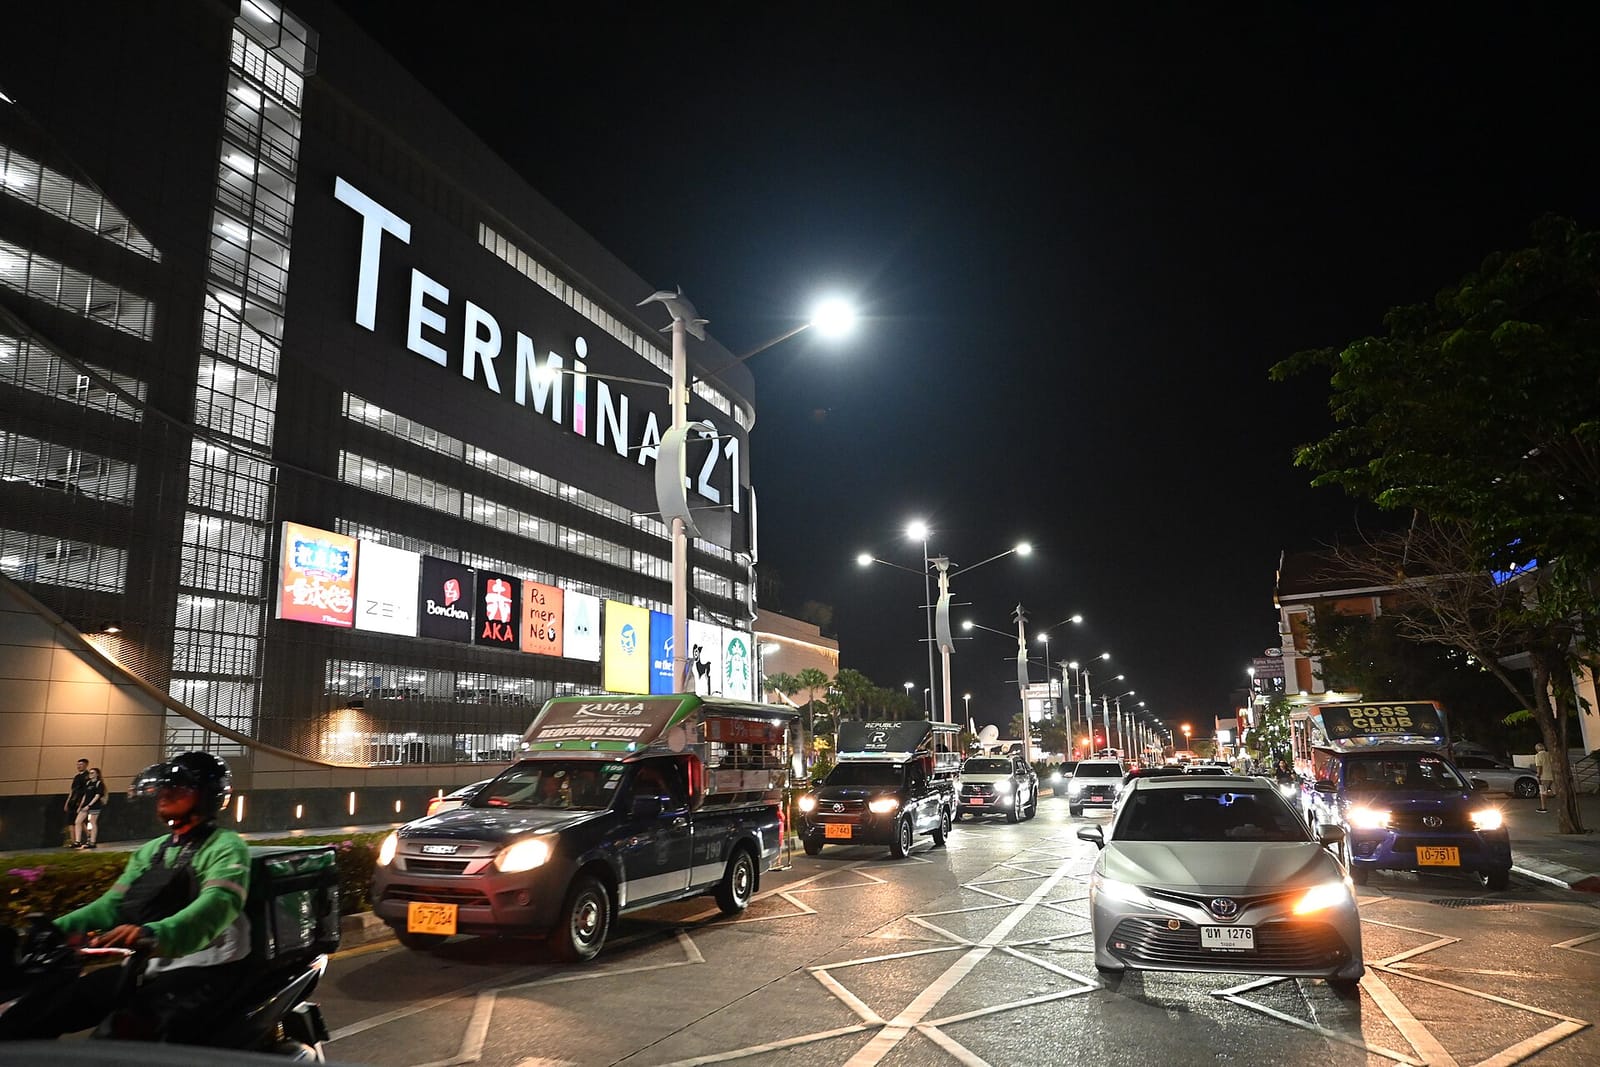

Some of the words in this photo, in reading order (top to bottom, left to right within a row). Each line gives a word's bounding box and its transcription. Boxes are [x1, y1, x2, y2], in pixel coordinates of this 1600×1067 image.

[334, 175, 692, 490] TERMiNA
[698, 419, 740, 514] 21
[531, 588, 546, 605] Ra
[427, 600, 469, 620] Bonchon
[482, 621, 514, 642] AKA
[575, 702, 645, 716] KAMAA
[1348, 706, 1409, 718] BOSS
[1352, 716, 1414, 729] CLUB
[536, 726, 604, 739] REOPENING
[605, 727, 645, 738] SOON
[1420, 849, 1457, 861] 10-7511
[1227, 928, 1252, 939] 1276
